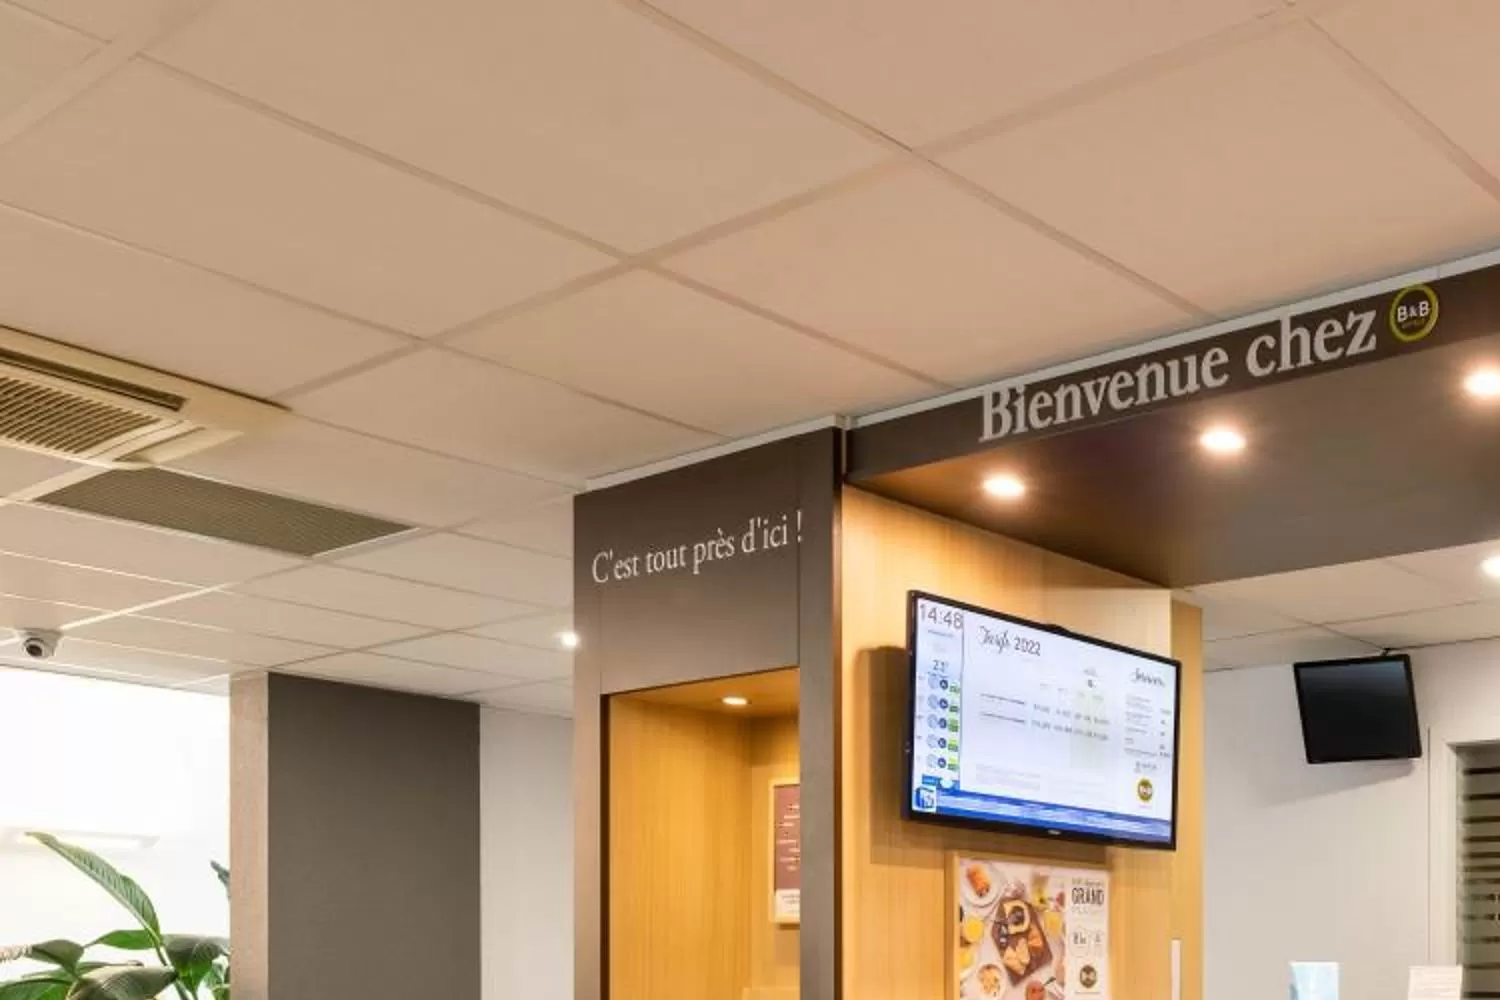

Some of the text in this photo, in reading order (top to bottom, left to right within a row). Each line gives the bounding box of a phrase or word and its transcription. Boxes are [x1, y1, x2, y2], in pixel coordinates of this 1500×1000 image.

[1397, 300, 1430, 323] B&B
[979, 303, 1377, 442] Bienvenue chez
[591, 549, 640, 583] C'est
[646, 544, 688, 573] tout
[693, 528, 735, 575] près
[741, 514, 788, 553] d'ici
[920, 603, 963, 629] 14:48
[1014, 635, 1041, 657] 2022
[1071, 887, 1105, 906] GRAND
